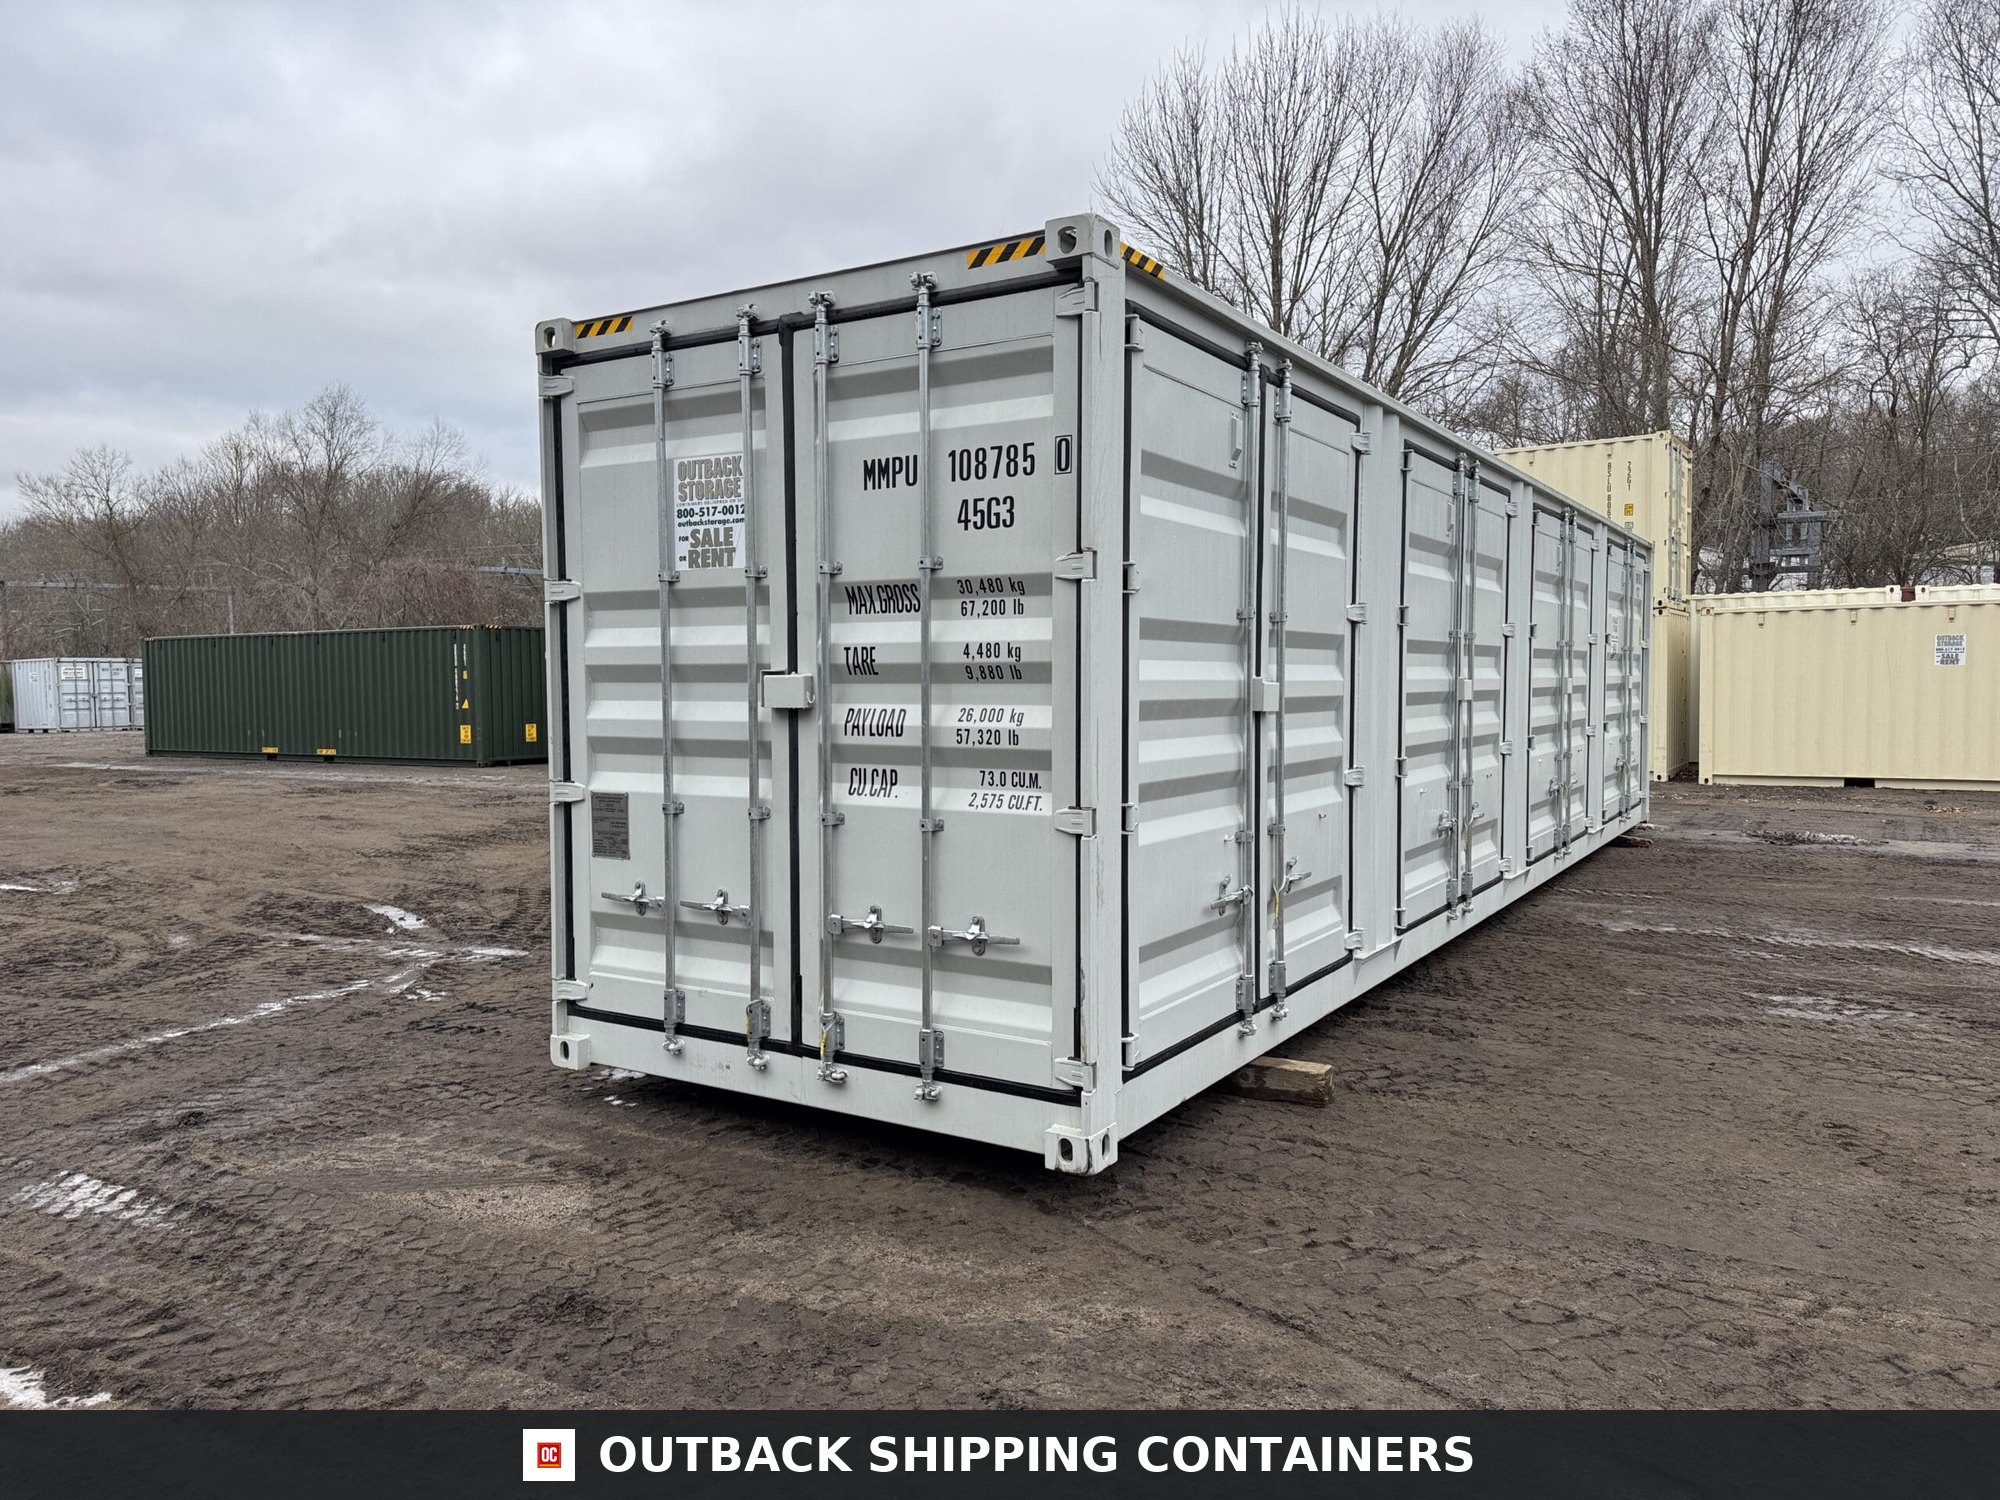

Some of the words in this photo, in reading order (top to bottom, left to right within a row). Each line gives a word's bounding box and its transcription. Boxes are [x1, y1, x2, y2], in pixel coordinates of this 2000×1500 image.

[677, 455, 743, 481] OUTBACK
[863, 454, 918, 491] MMPU
[948, 442, 1035, 482] 108785
[1056, 437, 1070, 472] 0
[678, 477, 742, 502] STORAGE
[676, 504, 745, 519] 800-517-0012
[957, 496, 1015, 531] 45G3
[690, 526, 733, 548] SALE
[688, 547, 736, 569] RENT
[844, 584, 921, 615] MAX.GROSS
[957, 578, 1004, 596] 30,480
[1009, 577, 1026, 596] kg
[961, 599, 1006, 619] 67,200
[1013, 599, 1024, 615] lb
[844, 646, 879, 675] TARE
[963, 642, 1001, 661] 4,480
[1007, 642, 1021, 662] kg
[965, 665, 1004, 682] 9,880
[1009, 665, 1022, 680] lb
[844, 708, 907, 738] PAYLOAD
[957, 708, 1004, 724] 26,000
[1009, 708, 1024, 727] kg
[956, 728, 1001, 746] 57,320
[1008, 729, 1019, 746] lb
[848, 767, 898, 799] CU.CAP.
[980, 770, 1007, 787] 73.0
[1011, 771, 1042, 789] CU.M.
[968, 792, 1004, 809] 2,575
[1007, 794, 1043, 811] CU.FT.
